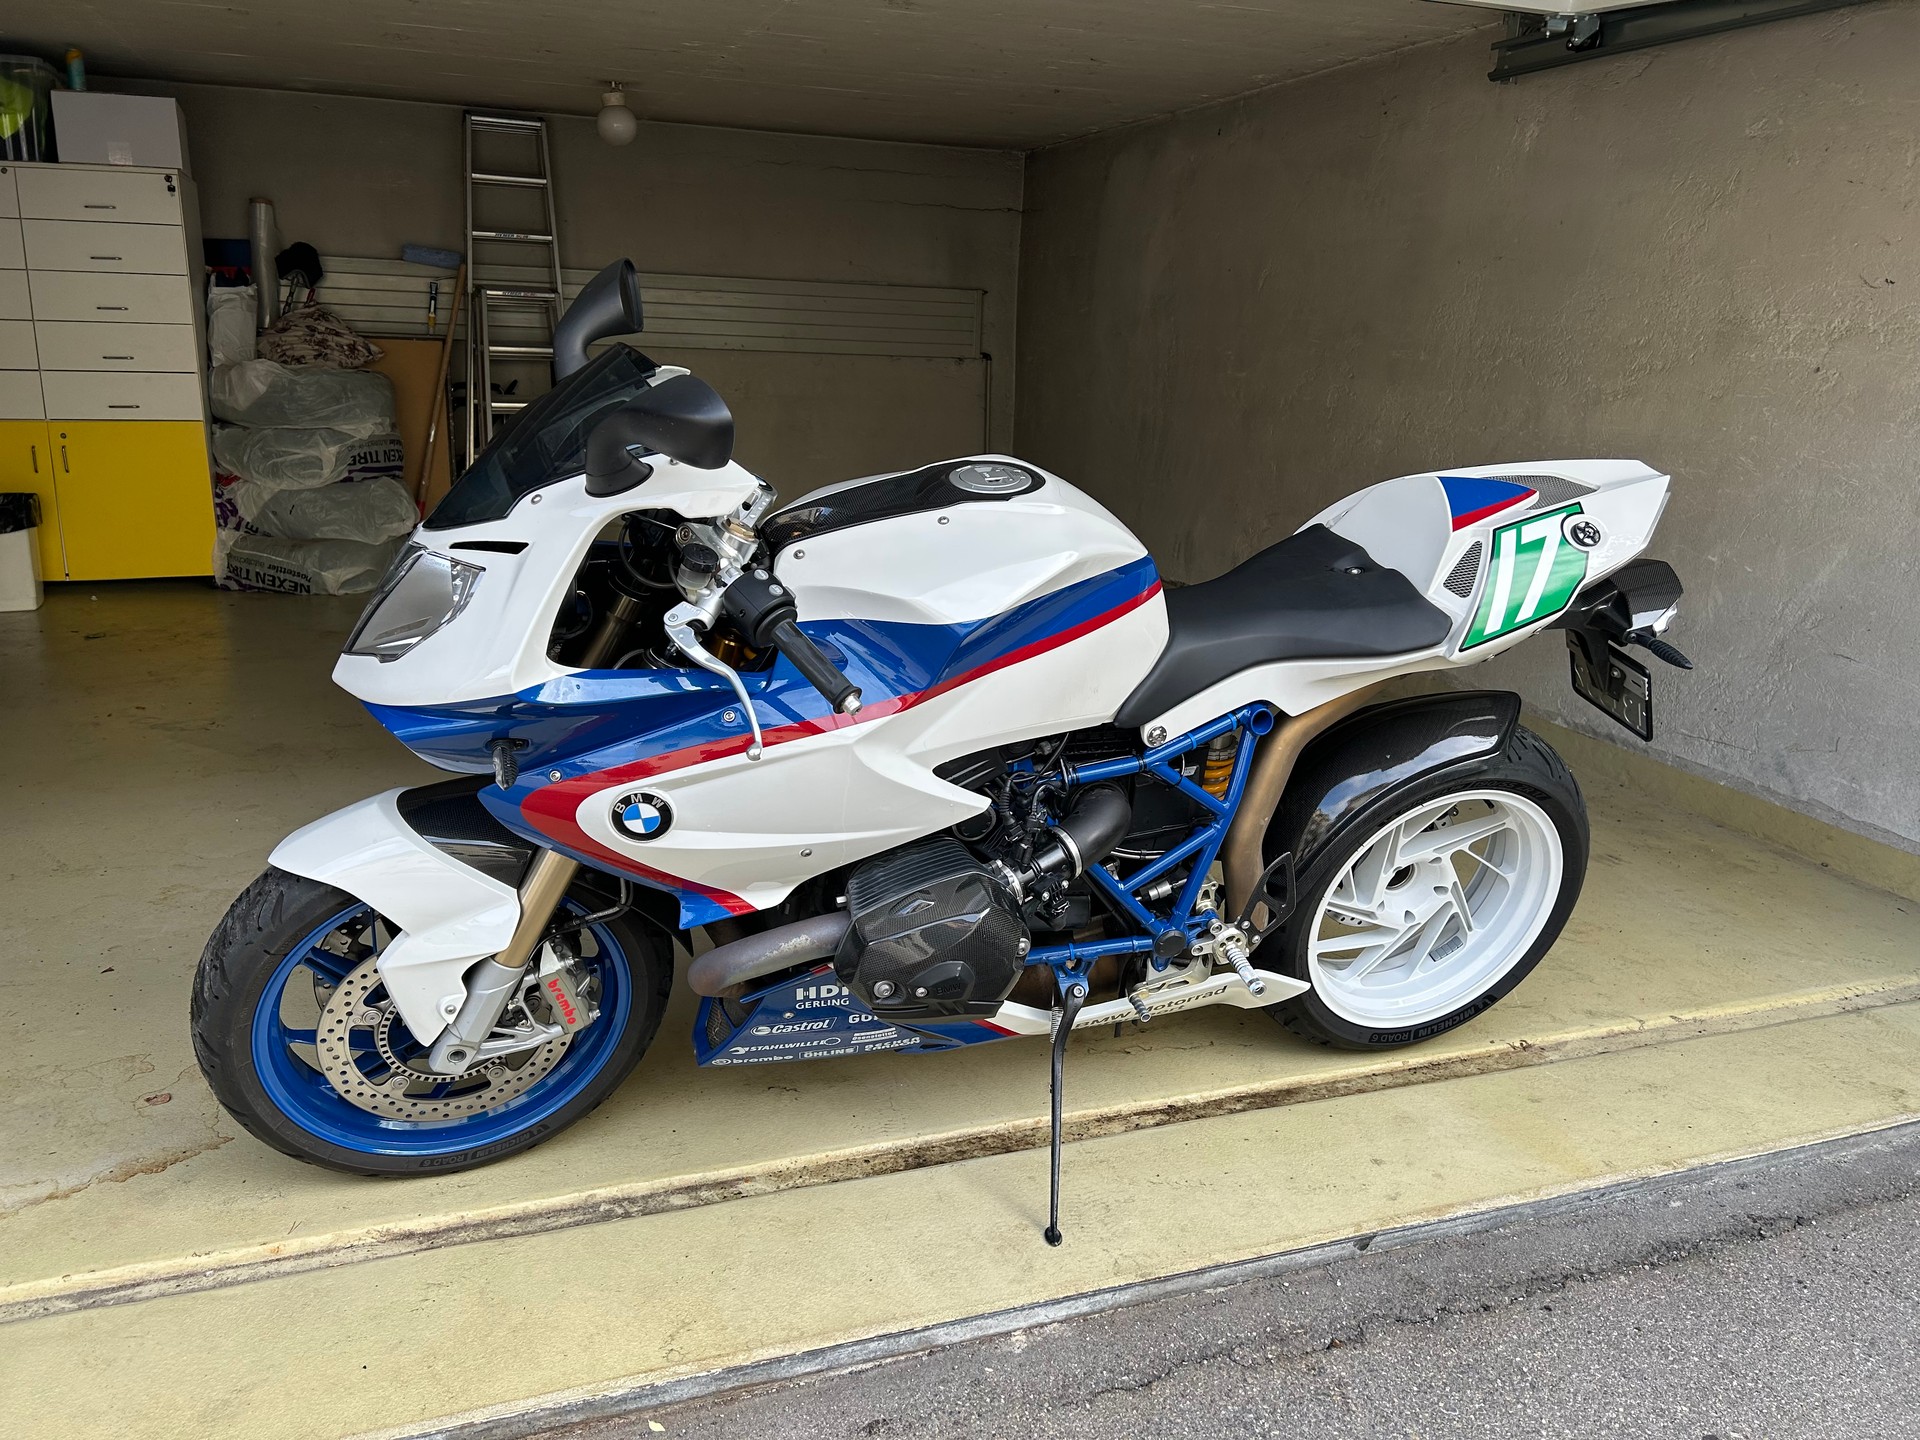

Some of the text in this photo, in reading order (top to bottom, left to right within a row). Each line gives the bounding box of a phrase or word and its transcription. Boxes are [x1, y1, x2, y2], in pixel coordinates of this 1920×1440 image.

[1484, 512, 1567, 635] 17
[255, 570, 311, 594] NEXEN
[614, 793, 665, 814] BMW
[796, 984, 849, 1000] HDI
[936, 983, 961, 995] BMW
[547, 978, 577, 1025] brembo
[795, 998, 849, 1010] GERLING
[772, 1019, 830, 1034] Castrol
[1075, 1011, 1131, 1029] BMW
[1419, 1006, 1475, 1038] MICHELIN
[1381, 1031, 1409, 1042] ROAD
[748, 1039, 827, 1052] STAHLWILLE
[804, 1047, 854, 1058] ÖHLINS
[733, 1054, 794, 1064] brembo
[476, 1131, 531, 1158] MICHELIN
[433, 1154, 465, 1167] ROAD
